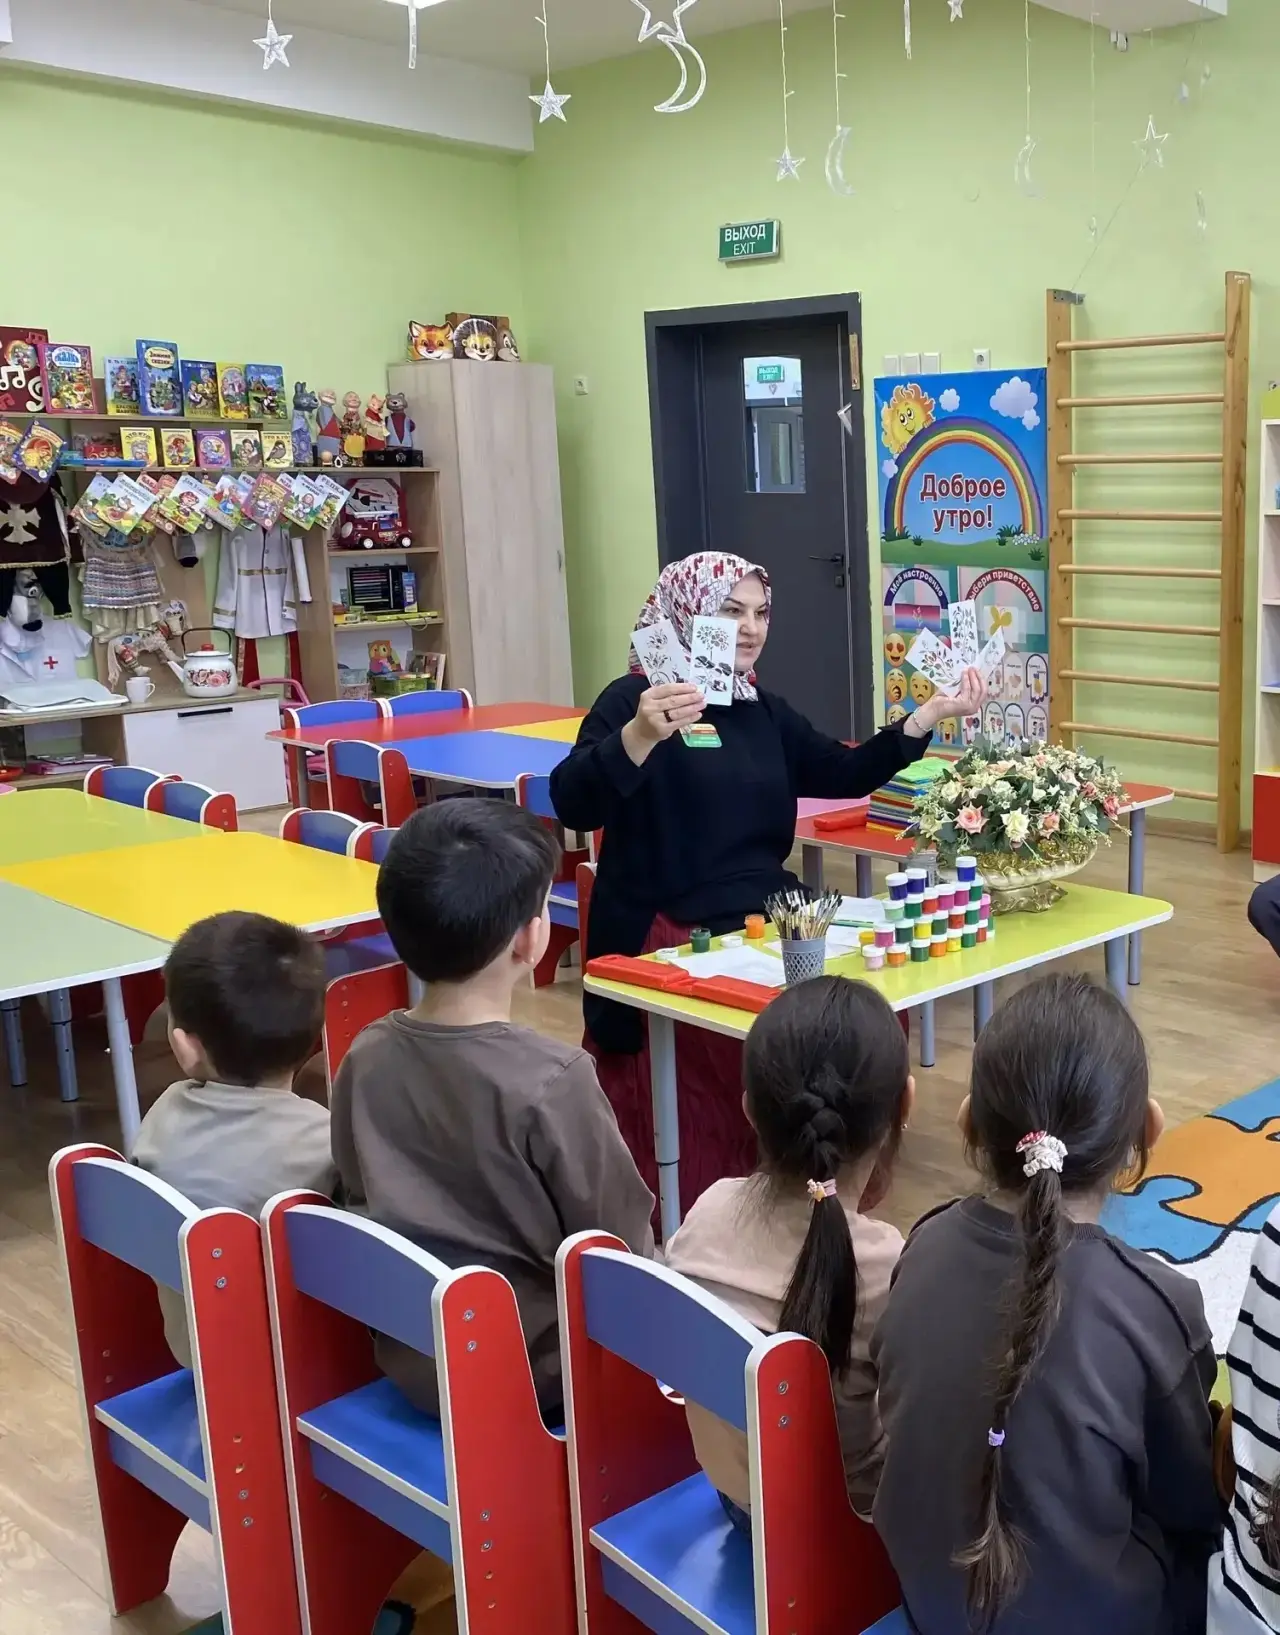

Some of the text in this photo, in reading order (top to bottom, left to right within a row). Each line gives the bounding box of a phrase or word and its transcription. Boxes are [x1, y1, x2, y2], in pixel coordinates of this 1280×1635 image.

[724, 223, 766, 242] ВЫХОД
[733, 241, 756, 256] EXIT
[920, 474, 1005, 502] Доброе
[933, 504, 992, 533] утро!
[902, 569, 944, 597] настроение
[968, 570, 1040, 611] ыбери приветствие
